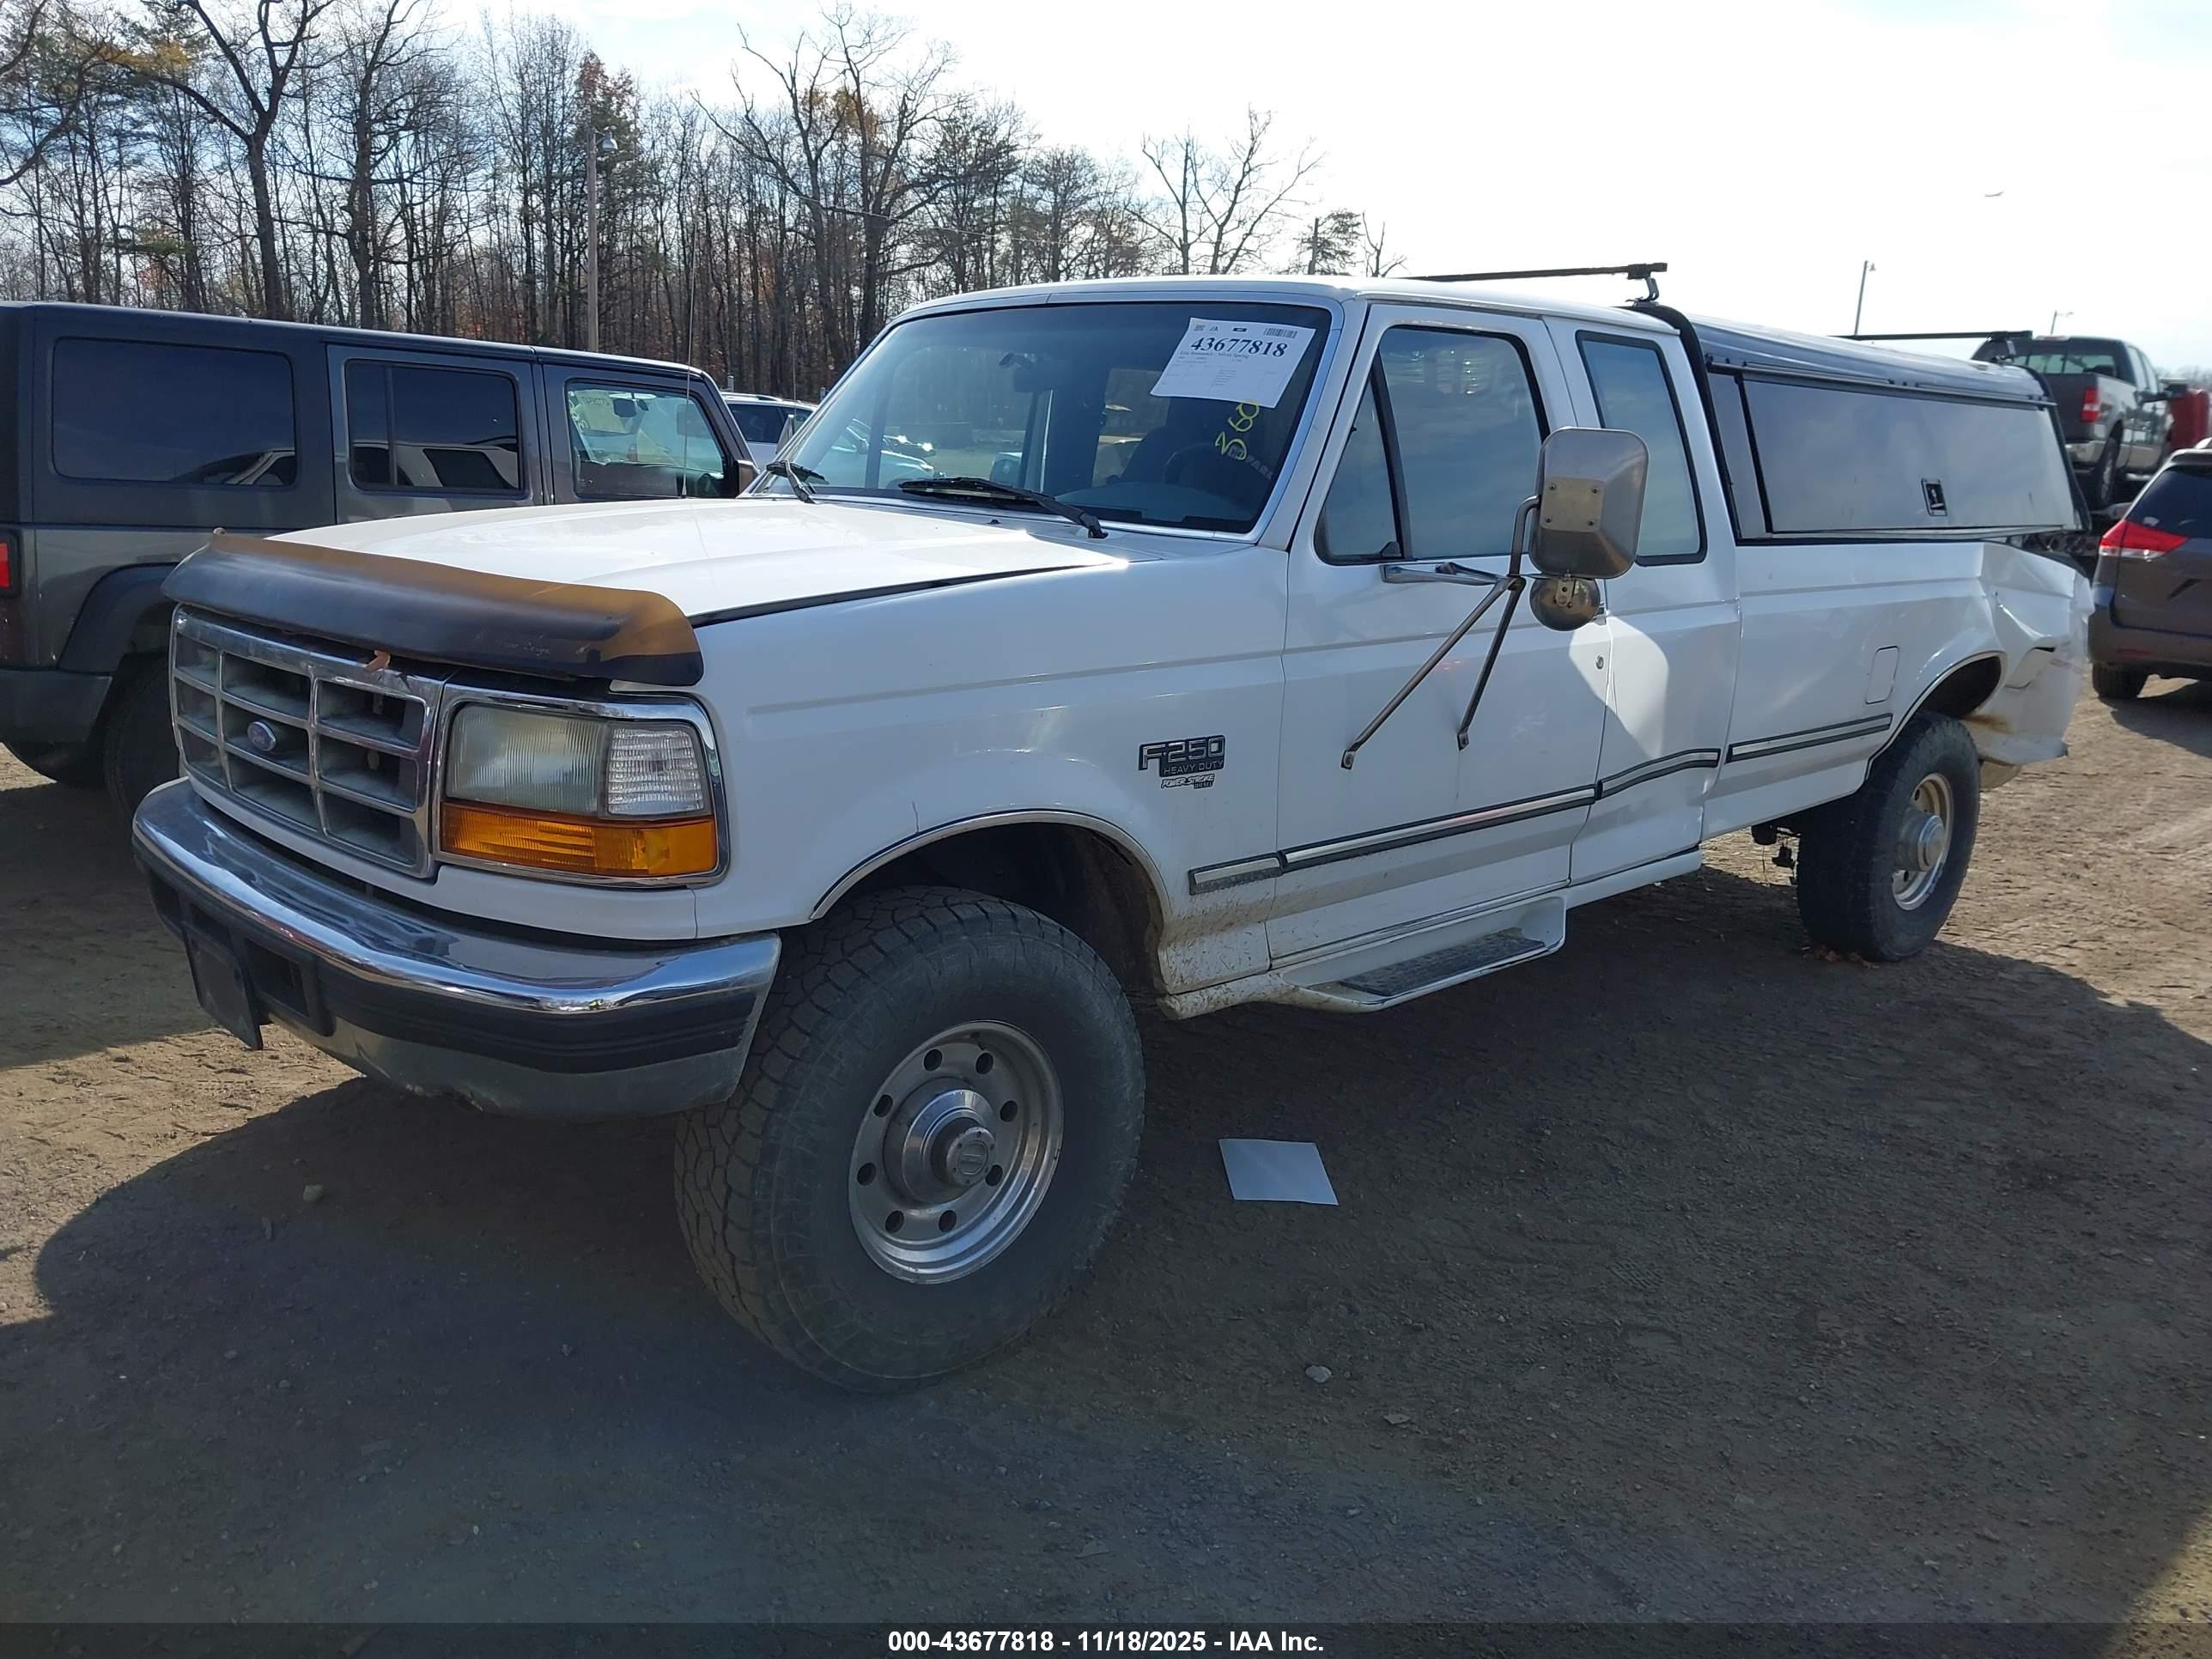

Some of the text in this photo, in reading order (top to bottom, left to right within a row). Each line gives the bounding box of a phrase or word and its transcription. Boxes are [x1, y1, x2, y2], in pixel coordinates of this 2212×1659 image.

[1190, 337, 1287, 357] 43677818
[1164, 760, 1224, 775] HEAVY DUTY
[1161, 774, 1215, 789] POWER STROKE
